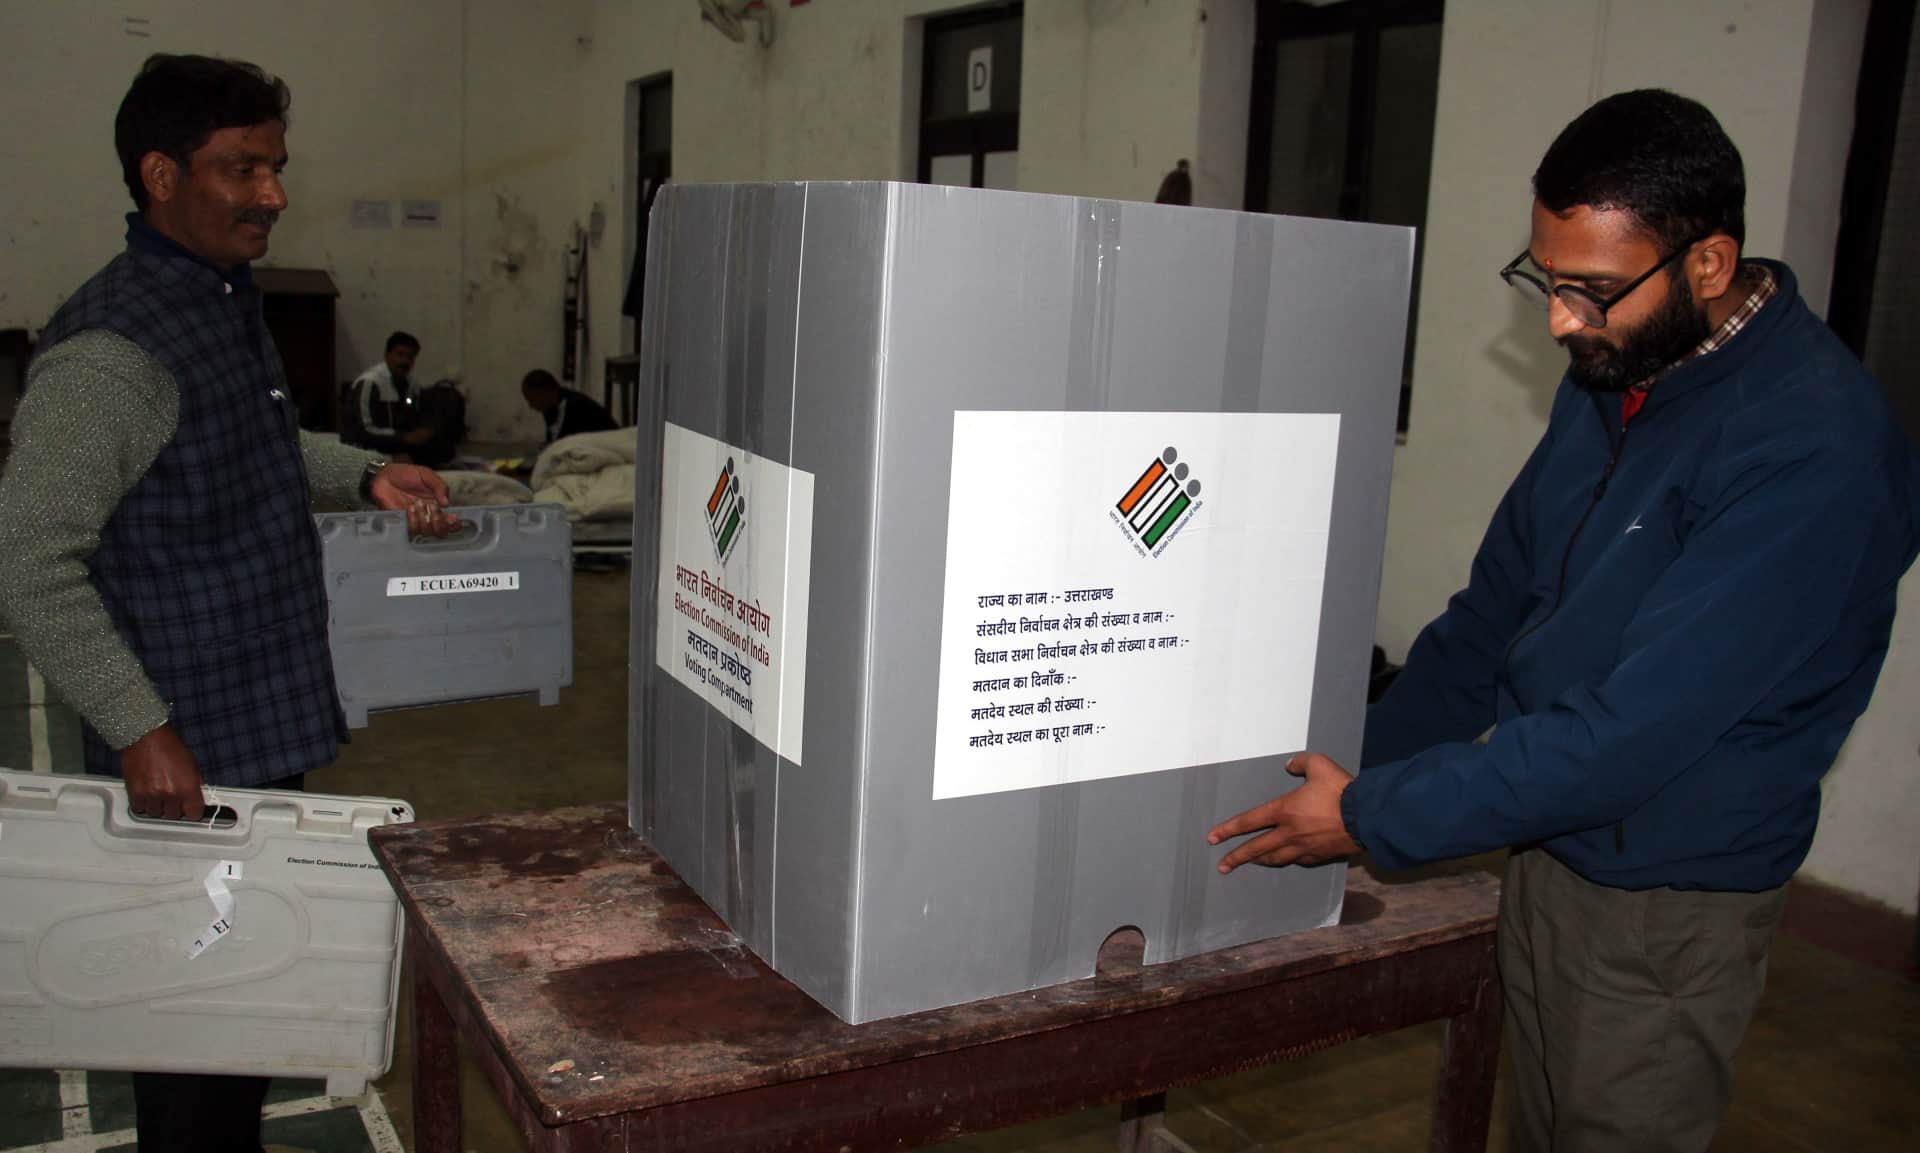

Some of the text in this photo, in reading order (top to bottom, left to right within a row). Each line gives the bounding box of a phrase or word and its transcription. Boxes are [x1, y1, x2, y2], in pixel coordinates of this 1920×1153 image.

[972, 61, 987, 92] D
[400, 582, 407, 592] 7
[420, 577, 499, 591] ECUEA69420
[977, 594, 1005, 609] राज्य
[1007, 592, 1023, 607] का
[1025, 591, 1048, 605] नाम
[1064, 587, 1115, 603] उत्तराखण्ड
[676, 564, 771, 638] भारत निर्वाचन आयोग
[674, 591, 770, 667] Election Commission of India
[976, 619, 1017, 637] संसदीय
[1019, 614, 1061, 635] निर्वाचन
[1062, 612, 1082, 631] क्षेत्र
[1084, 610, 1099, 629] की
[1101, 610, 1131, 628] संख्या
[1133, 612, 1141, 625] व
[1142, 610, 1164, 624] नाम
[687, 629, 752, 686] मतदान प्रकोष्ठ
[974, 647, 1009, 666] विधान
[1010, 647, 1035, 663] सभा
[1037, 641, 1078, 661] निर्वाचन
[1079, 638, 1099, 657] क्षेत्र
[1100, 636, 1115, 655] की
[1117, 636, 1146, 653] संख्या
[1149, 637, 1157, 650] व
[1158, 634, 1179, 649] नाम
[684, 651, 753, 714] Voting Compartment
[972, 677, 1011, 693] मतदान
[1013, 675, 1029, 690] का
[1031, 668, 1065, 688] दिनाँक
[971, 702, 1006, 721] मतदेय
[1008, 703, 1035, 718] स्थल
[1037, 697, 1052, 714] की
[1054, 695, 1085, 713] संख्या
[969, 729, 1004, 749] मतदेय
[1006, 730, 1033, 745] स्थल
[1035, 727, 1050, 742] का
[1052, 724, 1070, 743] पूरा
[1072, 722, 1094, 737] नाम
[287, 857, 315, 865] Election
[316, 859, 358, 868] Commission
